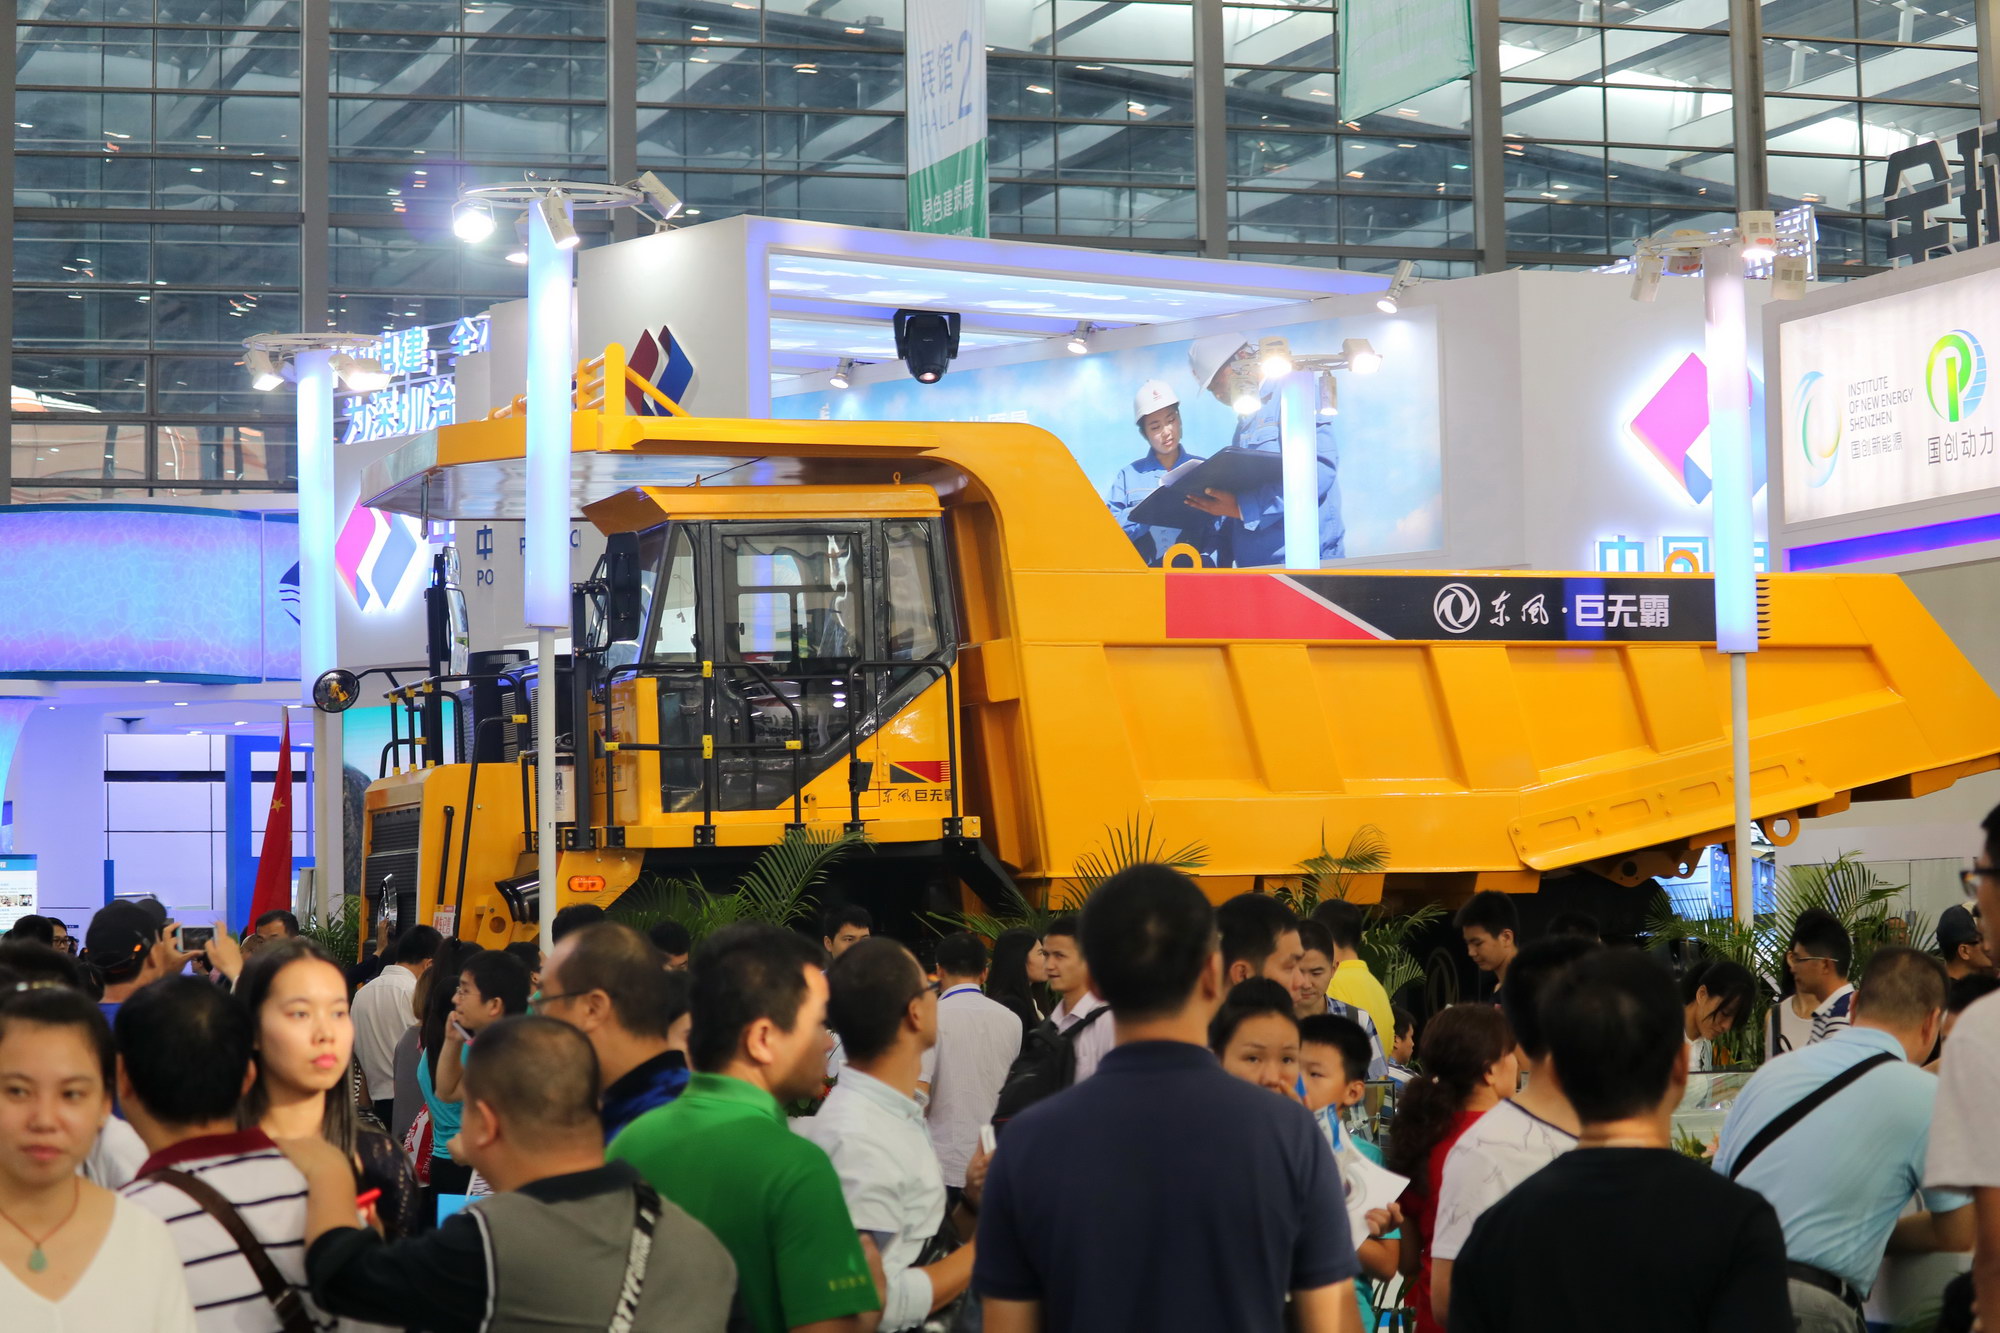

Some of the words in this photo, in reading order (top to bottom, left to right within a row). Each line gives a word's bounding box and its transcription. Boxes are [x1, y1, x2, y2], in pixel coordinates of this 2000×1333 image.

[920, 41, 953, 105] 展馆
[958, 30, 973, 119] 2
[920, 103, 954, 139] HALL
[922, 179, 974, 226] 绿色建筑展
[1847, 375, 1888, 398] INSTITUTE
[1848, 399, 1859, 415] OF
[1861, 396, 1880, 412] NEW
[1881, 387, 1914, 408] ENERGY
[1849, 410, 1892, 432] SHENZHEN
[1850, 431, 1903, 460] 国创新能源
[1928, 426, 1994, 466] 国创动力
